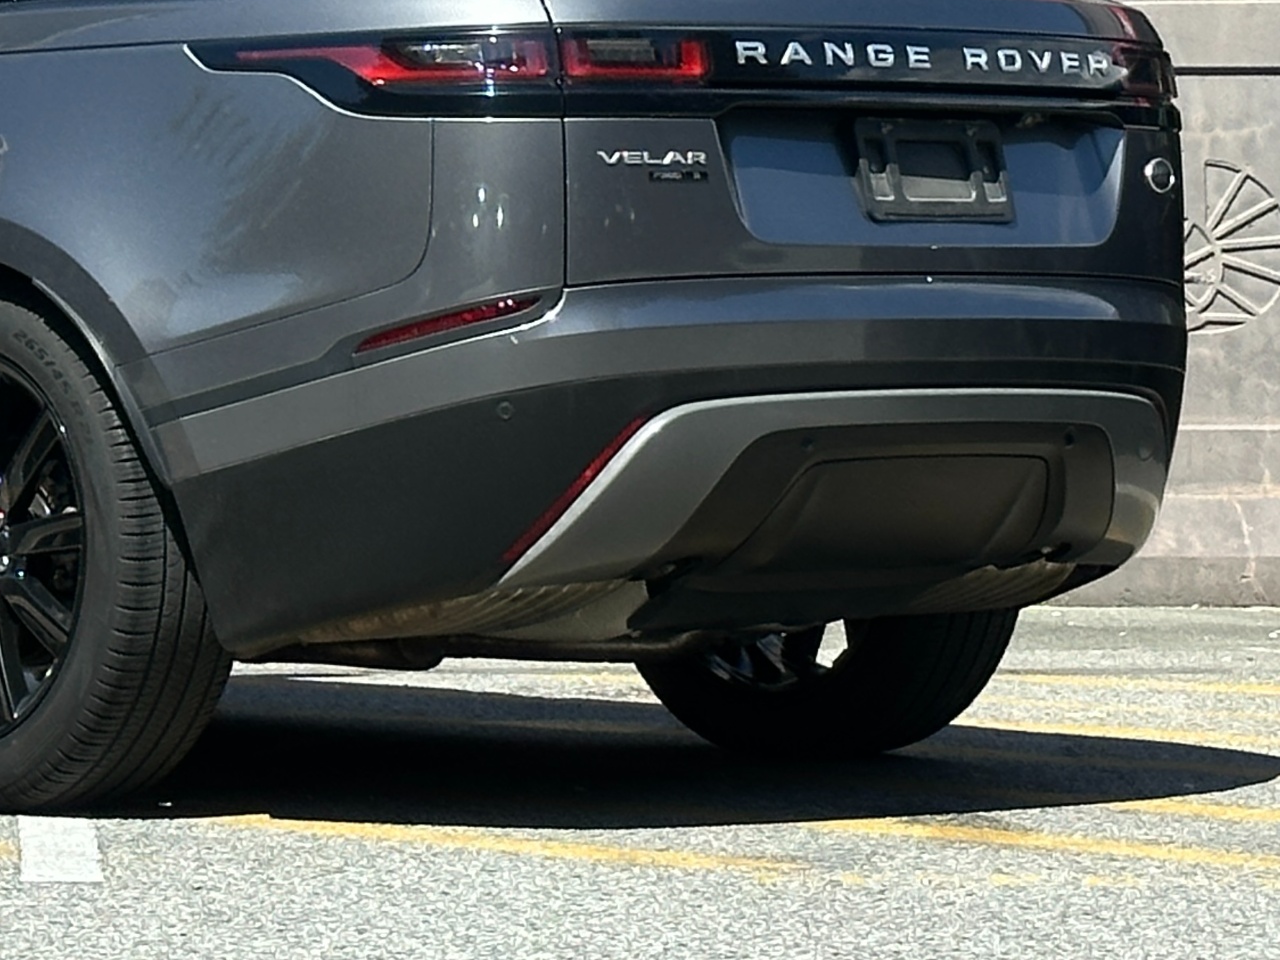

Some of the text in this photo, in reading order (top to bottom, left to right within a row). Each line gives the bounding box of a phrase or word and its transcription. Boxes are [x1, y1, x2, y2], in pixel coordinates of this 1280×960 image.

[734, 40, 1108, 76] RANGE ROVER
[596, 149, 706, 165] VELAR
